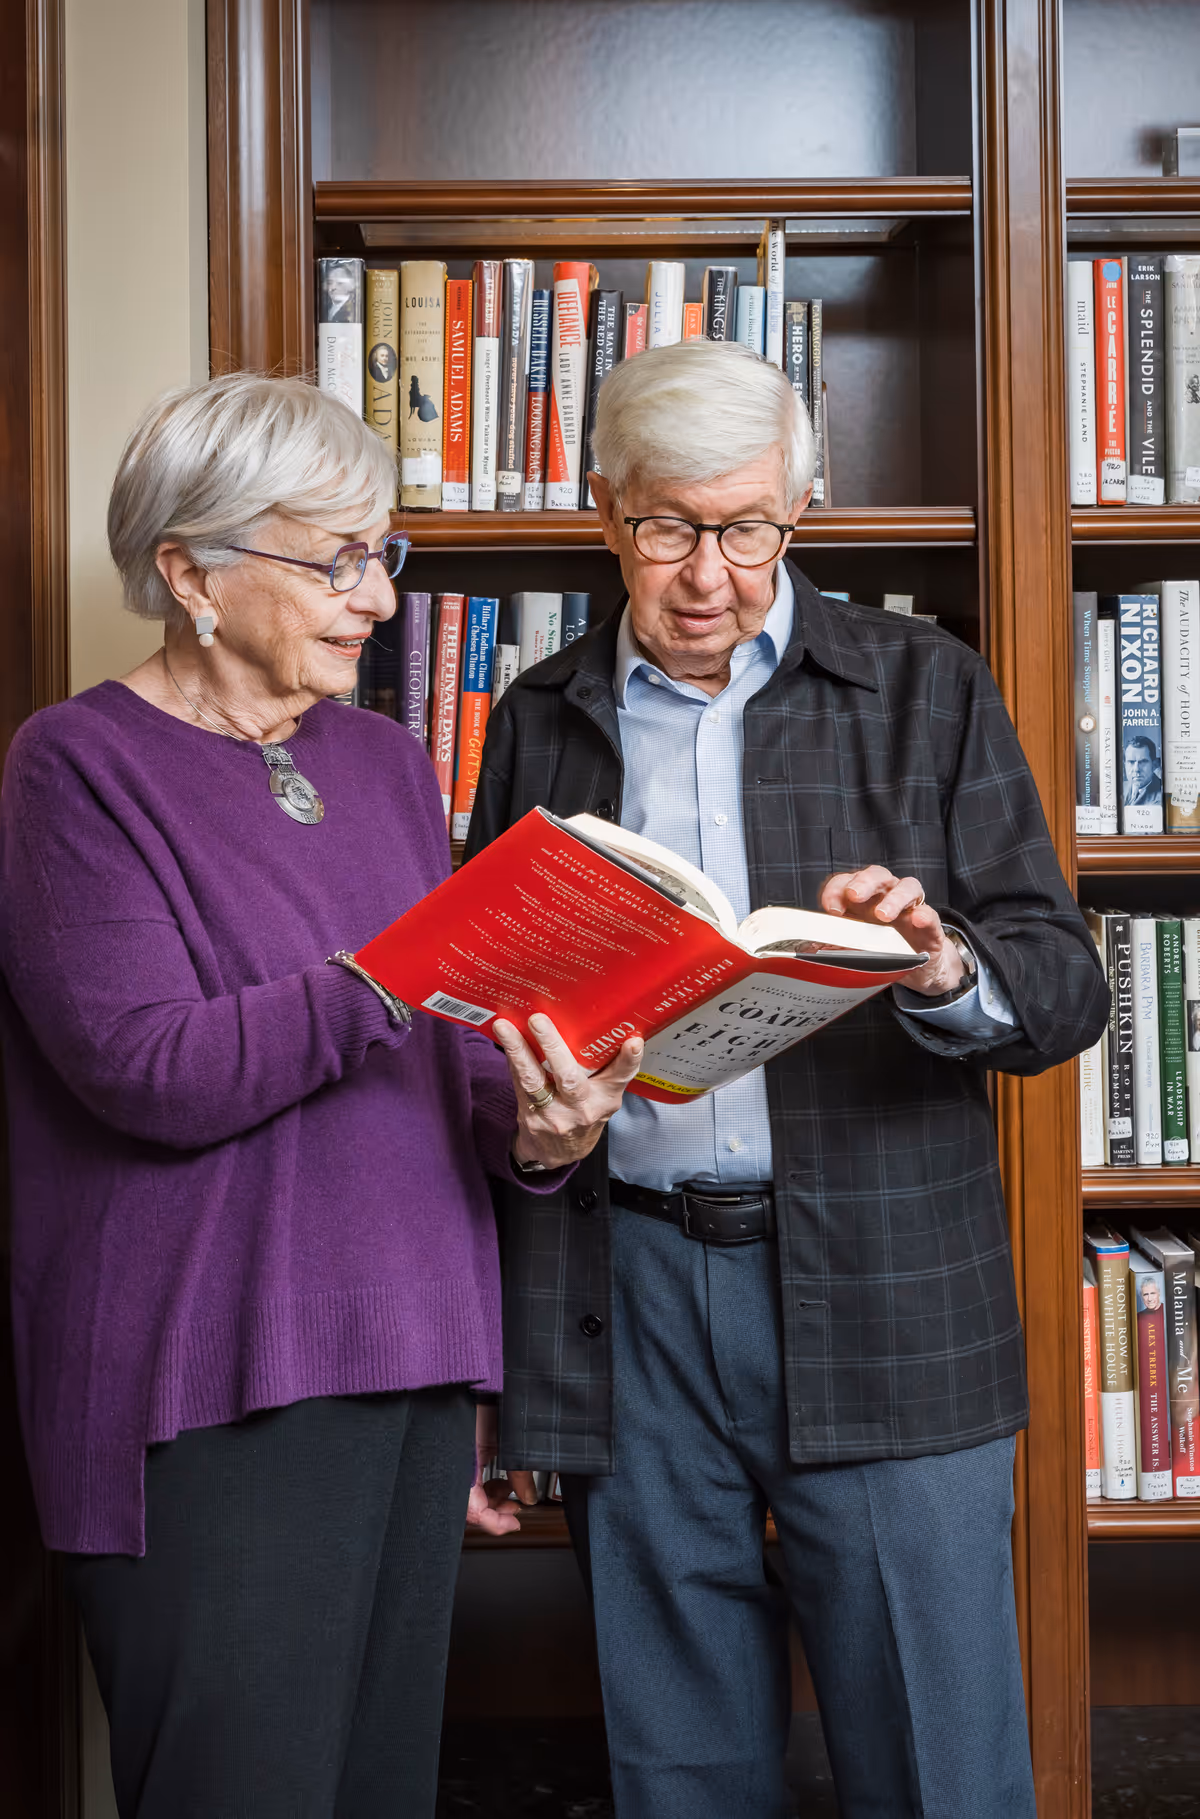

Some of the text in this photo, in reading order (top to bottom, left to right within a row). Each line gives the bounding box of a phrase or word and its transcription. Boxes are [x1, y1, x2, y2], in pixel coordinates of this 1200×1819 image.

[770, 219, 780, 272] The World
[372, 300, 381, 338] QUINCY
[380, 299, 392, 338] JOHN
[405, 296, 441, 308] LOUISA
[484, 278, 495, 324] ALAN ALDA
[557, 291, 581, 348] DEFIANCE
[654, 292, 664, 334] JULIA
[712, 278, 726, 340] THE KING'S
[1077, 300, 1090, 335] maid
[1107, 296, 1116, 308] LE
[530, 299, 548, 388] RUSSELL BAKER
[595, 300, 606, 377] THE RED COAT
[604, 306, 616, 372] THE MAN IN
[792, 326, 804, 364] HERO
[812, 304, 822, 366] CARAVAGGIO
[1140, 308, 1154, 395] SPLENDID
[450, 320, 464, 442] SAMUEL ADAMS
[1080, 362, 1088, 414] STEPHANIE
[1107, 311, 1118, 432] CARRÉ
[558, 352, 576, 445] LADY ANNE BARNARD
[814, 400, 822, 431] Francine
[530, 396, 543, 450] LOOKING
[552, 420, 562, 452] STEPHEN
[528, 450, 542, 483] BACK
[1104, 448, 1120, 456] PIGEON
[1142, 438, 1155, 474] VILE
[548, 612, 557, 626] No
[1179, 590, 1190, 608] The
[470, 625, 480, 652] Chelsea
[478, 605, 492, 689] Hillary Rodham Clinton
[1082, 610, 1092, 703] When Time Stopped
[1120, 603, 1142, 703] NIXON
[1142, 604, 1159, 704] RICHARD
[1180, 610, 1190, 679] AUDACITY
[468, 653, 478, 679] Clinton
[440, 622, 458, 762] THE FINAL DAYS
[474, 698, 482, 710] THE
[1176, 684, 1190, 697] of
[1122, 718, 1160, 726] FARRELL
[1123, 708, 1160, 717] JOHN A.
[1180, 700, 1190, 738] HOPE
[472, 729, 480, 737] OF
[465, 738, 481, 786] GUTSY
[1084, 740, 1092, 769] Ariana
[1104, 728, 1112, 800] ISAAC NEWTON
[553, 855, 595, 884] BETWEEN
[597, 884, 616, 896] THE
[618, 896, 649, 915] WORLD
[650, 913, 670, 926] AND
[671, 926, 685, 937] ME
[557, 878, 587, 899] wondering
[559, 849, 586, 869] PRAISE
[599, 875, 645, 904] TA-NEHISI
[647, 903, 681, 925] COATES
[495, 915, 522, 936] FIRING
[538, 943, 552, 952] ALL
[522, 907, 557, 930] MICHIKO
[551, 897, 615, 934] TONI MORRISON
[603, 911, 621, 923] James
[449, 942, 473, 962] moment
[1163, 934, 1171, 974] ROBERTS
[1172, 934, 1180, 974] ANDREW
[654, 958, 734, 1013] EIGHT YEARS
[1118, 944, 1133, 1054] PUSHKIN
[1140, 942, 1154, 1020] BARBARA PYM
[580, 1021, 636, 1060] COATES
[1108, 1020, 1116, 1032] Age
[646, 1074, 665, 1086] PARK
[1166, 1082, 1174, 1092] IN
[1176, 1070, 1184, 1126] LEADERSHIP
[1084, 1319, 1092, 1360] SISTERS
[1104, 1268, 1117, 1386] THE WHITE HOUSE
[1116, 1278, 1128, 1376] FRONT ROW AT
[1172, 1272, 1192, 1394] Melania and Me
[1148, 1322, 1160, 1455] ALEX TREBEK THE ANSWER
[1178, 1426, 1186, 1454] Wolkoff
[1186, 1407, 1194, 1442] Stephanie
